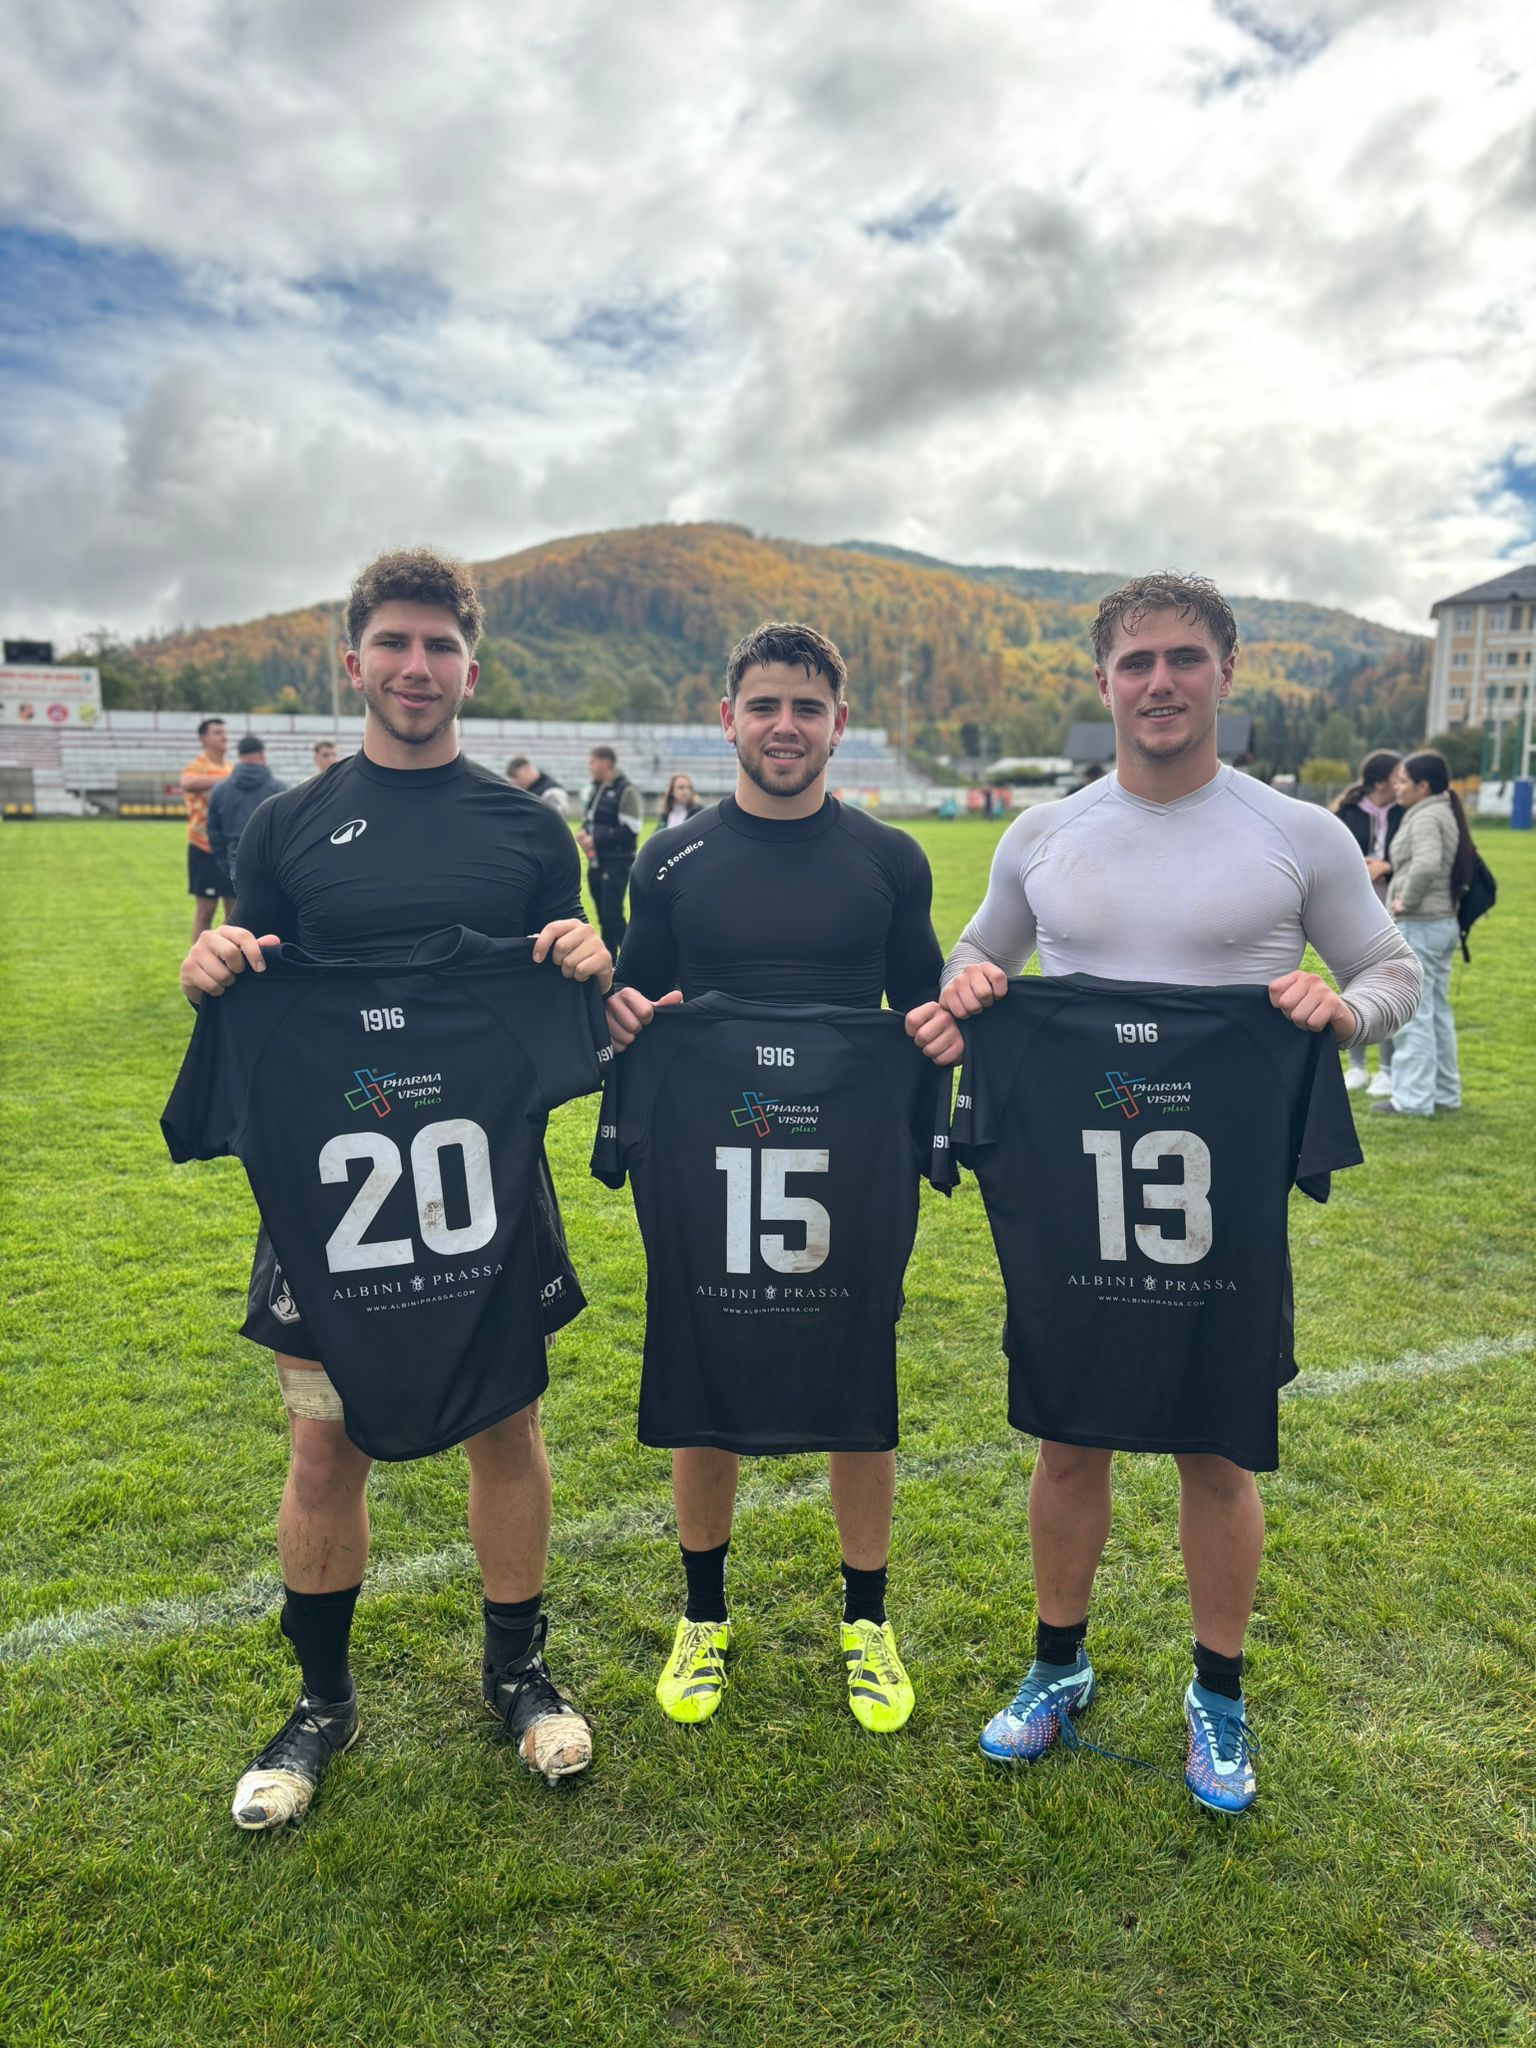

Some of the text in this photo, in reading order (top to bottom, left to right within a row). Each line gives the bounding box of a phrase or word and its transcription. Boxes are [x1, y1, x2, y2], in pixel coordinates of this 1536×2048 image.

[360, 1007, 405, 1032] 1916
[1114, 1022, 1158, 1043] 1916
[596, 1045, 614, 1062] 191
[756, 1046, 795, 1067] 1916
[382, 1073, 442, 1089] PHARMA
[1132, 1082, 1192, 1092] PHARMA
[397, 1085, 442, 1100] VISION
[1146, 1094, 1191, 1104] VISION
[414, 1097, 442, 1109] plus
[766, 1104, 819, 1113] PHARMA
[1162, 1104, 1190, 1114] plus
[778, 1116, 818, 1125] VISION
[791, 1125, 816, 1134] plus
[933, 1135, 950, 1149] 191
[318, 1118, 497, 1273] 20
[1082, 1130, 1213, 1265] 13
[716, 1146, 831, 1274] 15
[332, 1264, 503, 1300] ALBINI PRASSA
[1067, 1275, 1238, 1291] ALBINI PRASSA
[696, 1285, 850, 1299] ALBINI PRASSA
[366, 1289, 476, 1312] WWW.ALBINIPRASSA.COM
[1098, 1295, 1205, 1307] WWW.ALBINIPRASSA.COM
[723, 1307, 820, 1315] WWW.ALBINIPRASSA.COM
